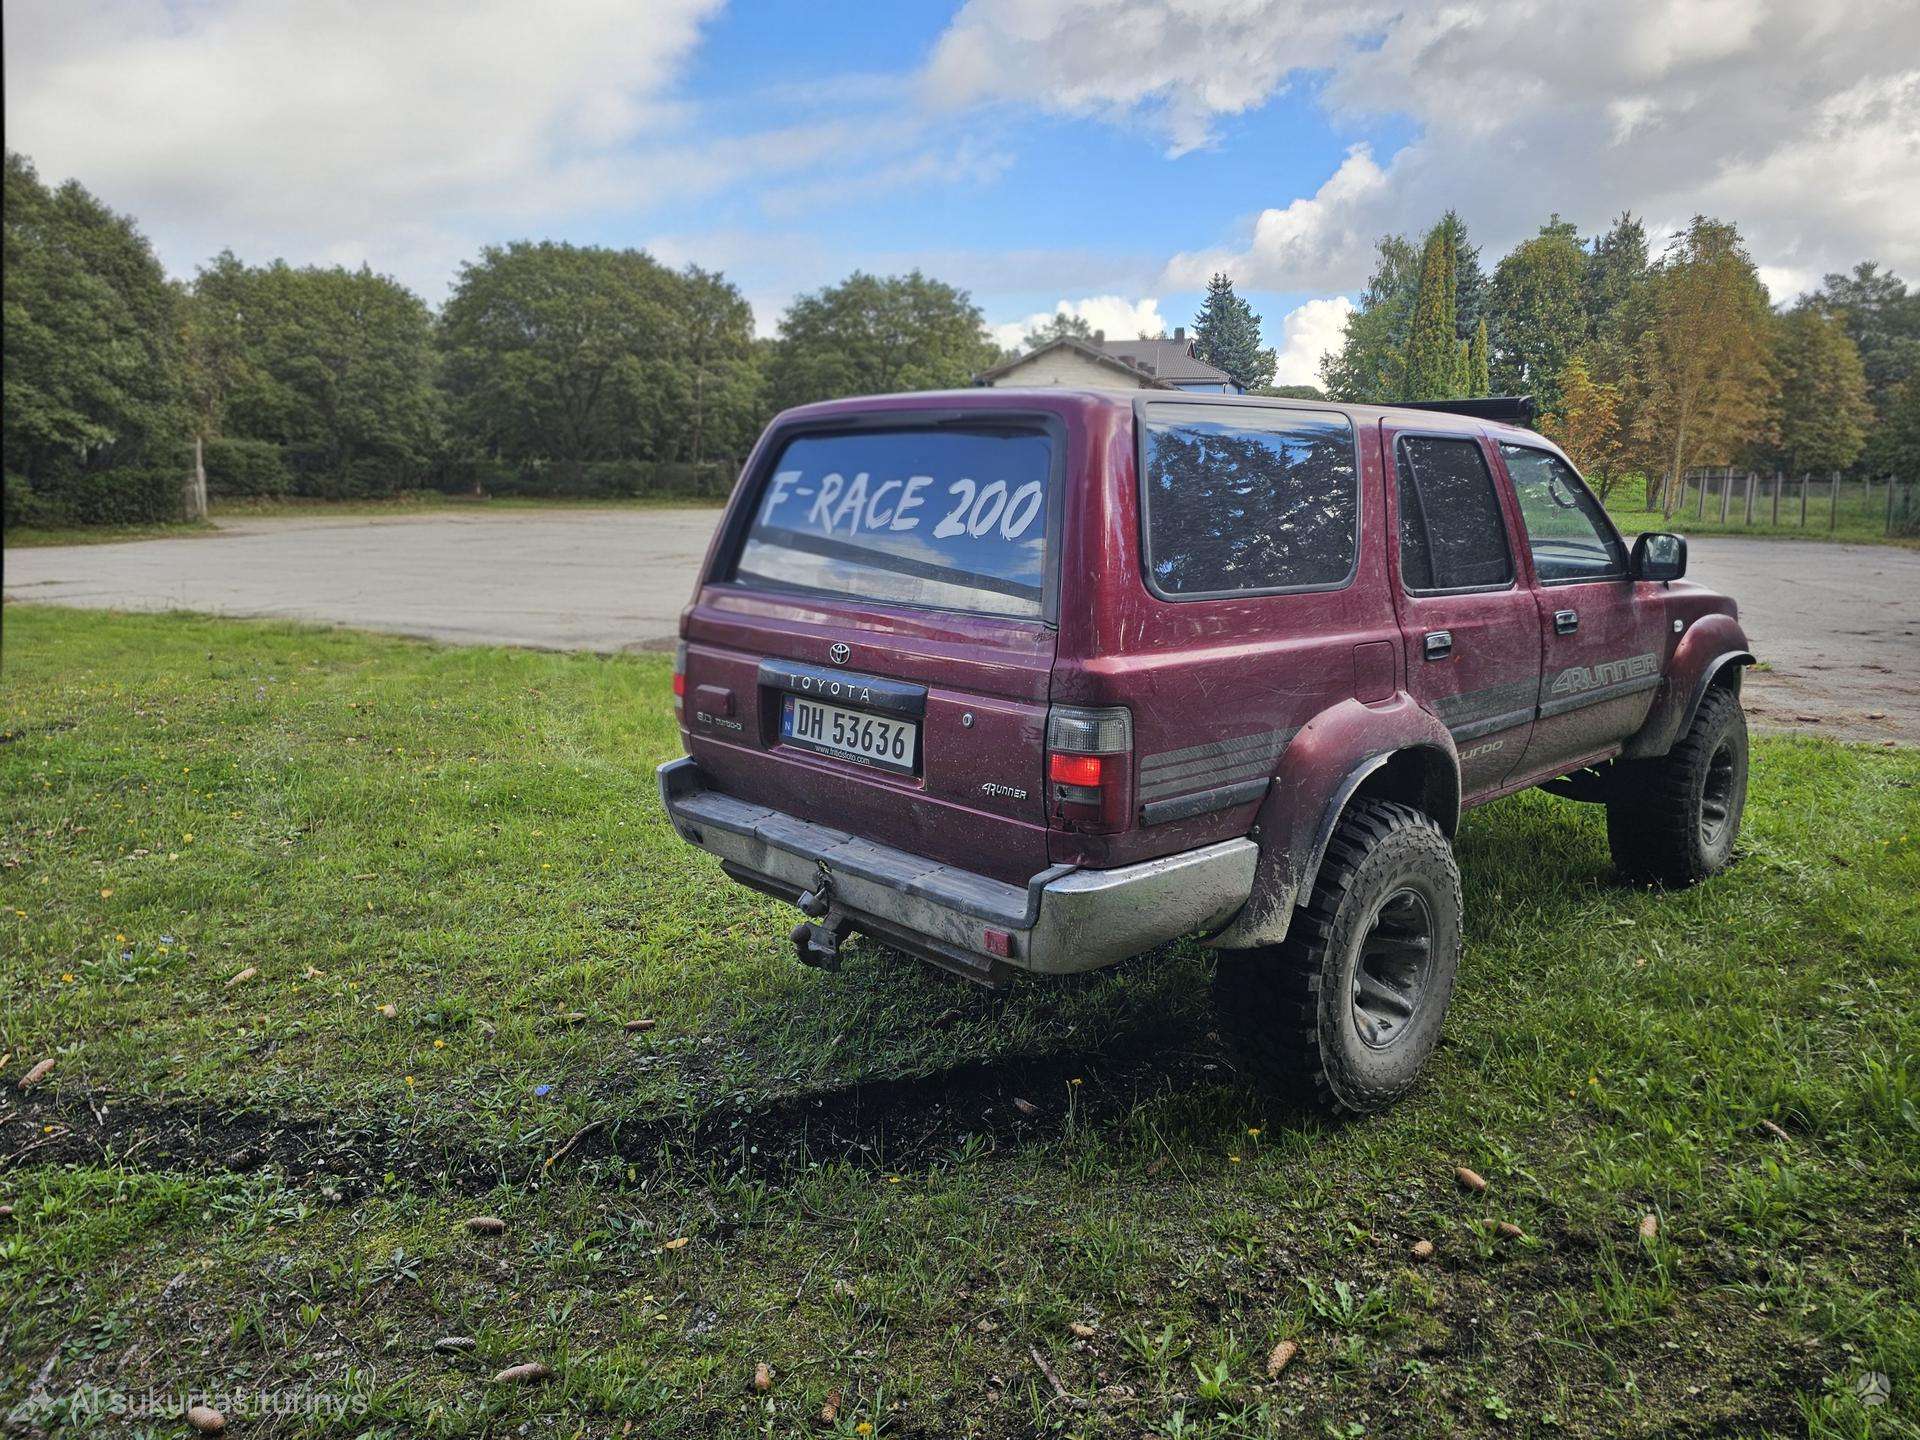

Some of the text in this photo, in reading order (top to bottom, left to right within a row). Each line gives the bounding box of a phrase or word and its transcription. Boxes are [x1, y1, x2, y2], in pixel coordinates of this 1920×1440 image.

[761, 471, 1043, 541] F-RACE 200
[790, 674, 870, 702] TOYOTA
[784, 720, 791, 731] N
[796, 703, 905, 760] DH 53636
